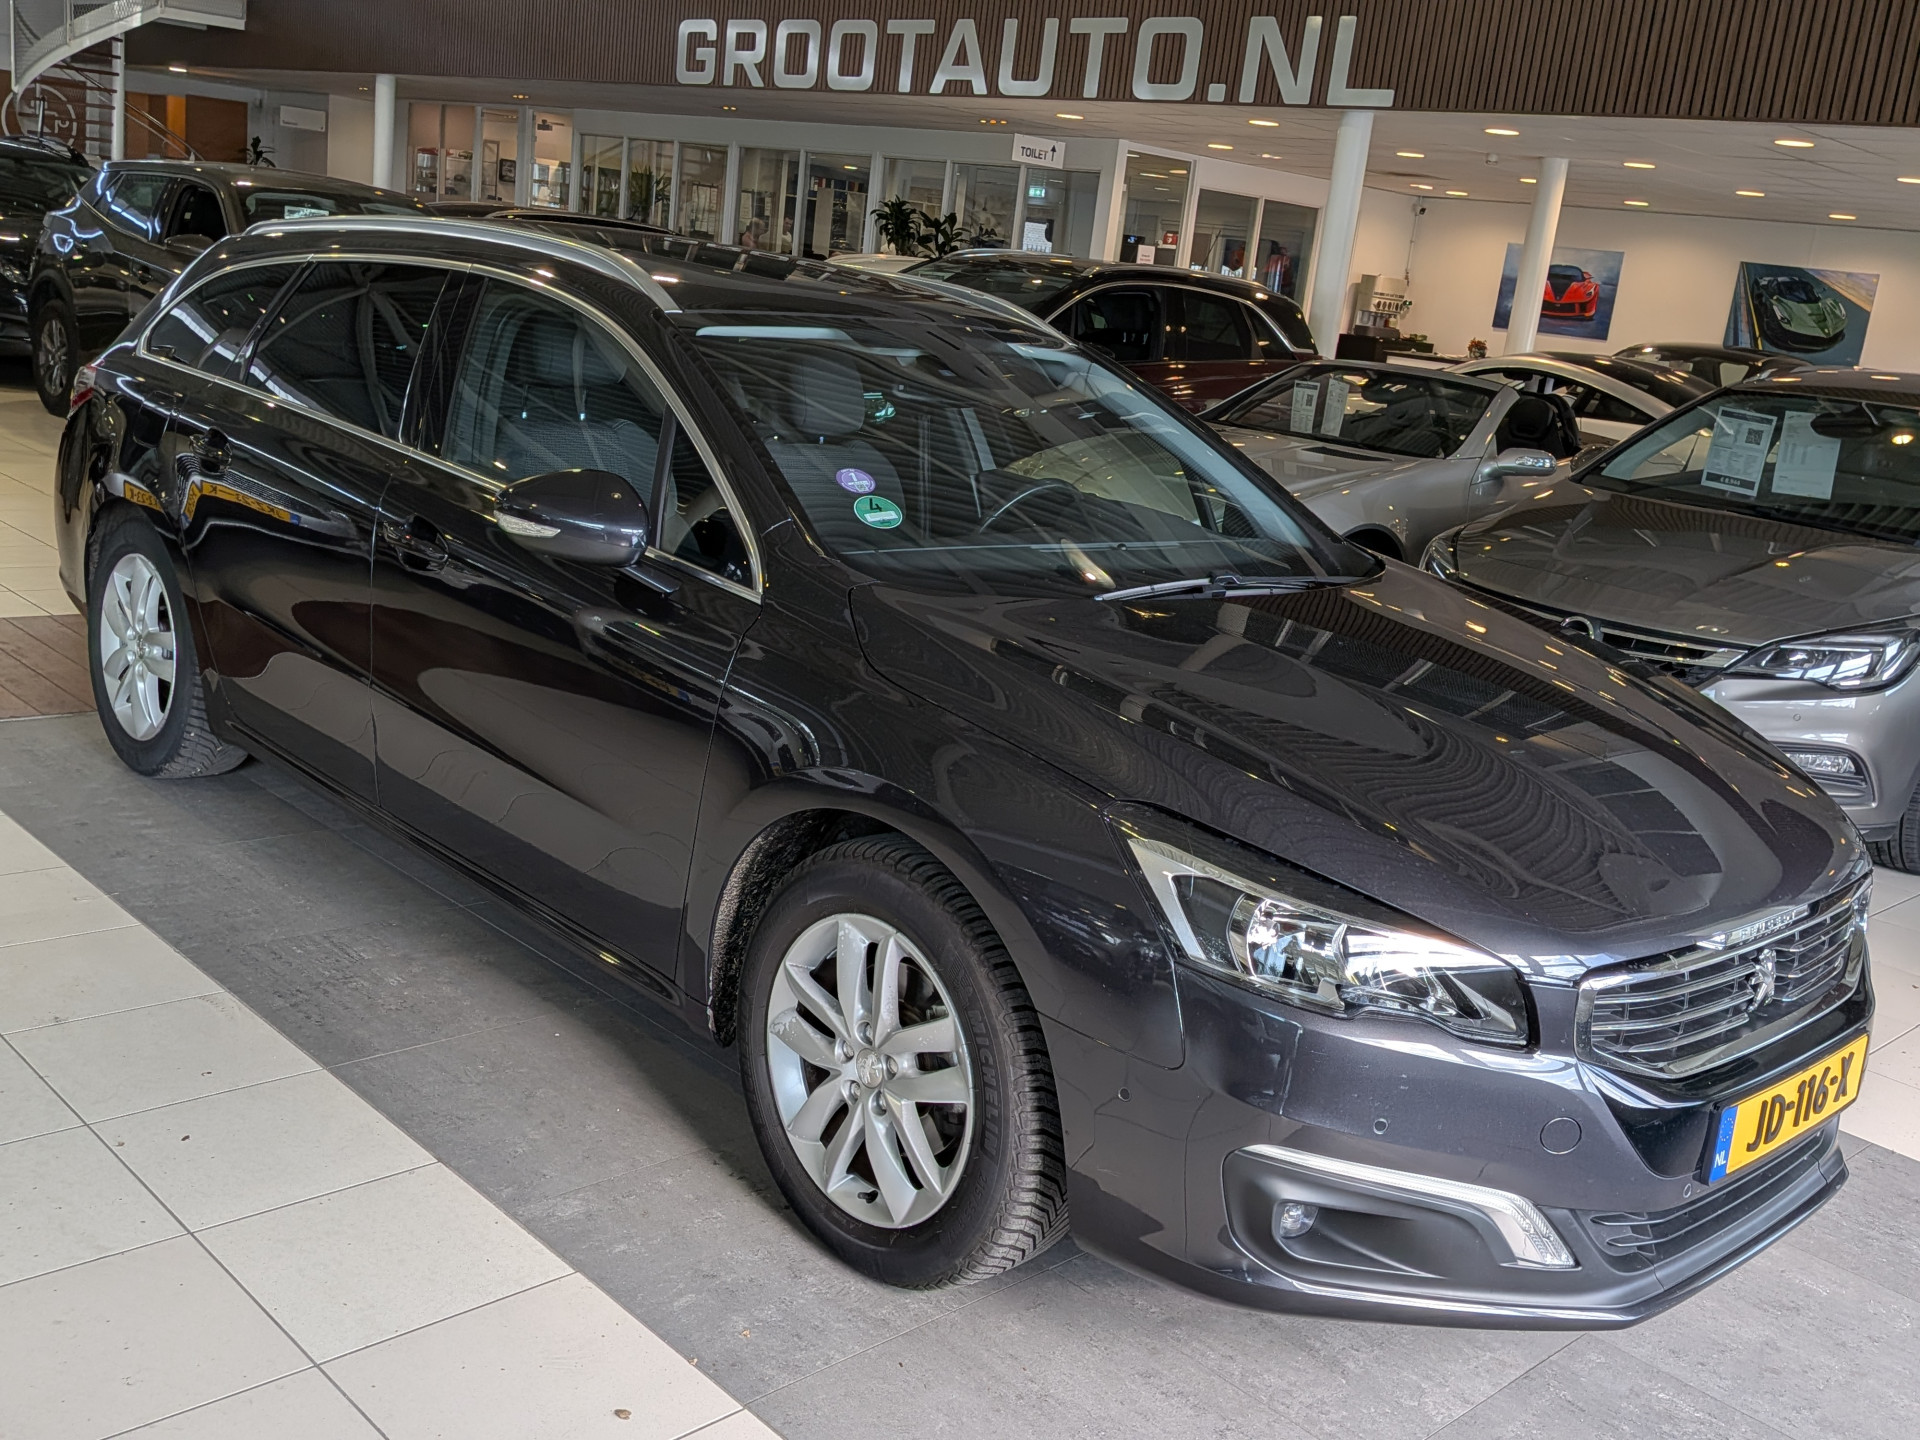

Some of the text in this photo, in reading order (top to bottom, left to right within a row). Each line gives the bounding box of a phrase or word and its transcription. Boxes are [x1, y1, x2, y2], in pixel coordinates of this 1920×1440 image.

[676, 15, 1394, 107] GROOTAUTO.NL
[1021, 146, 1049, 161] TOILET
[869, 498, 882, 511] 4
[1740, 909, 1796, 940] PEUGEOT
[967, 1008, 997, 1157] MICHELIN
[1746, 1051, 1855, 1153] JD-116-X
[1714, 1150, 1727, 1169] NL
